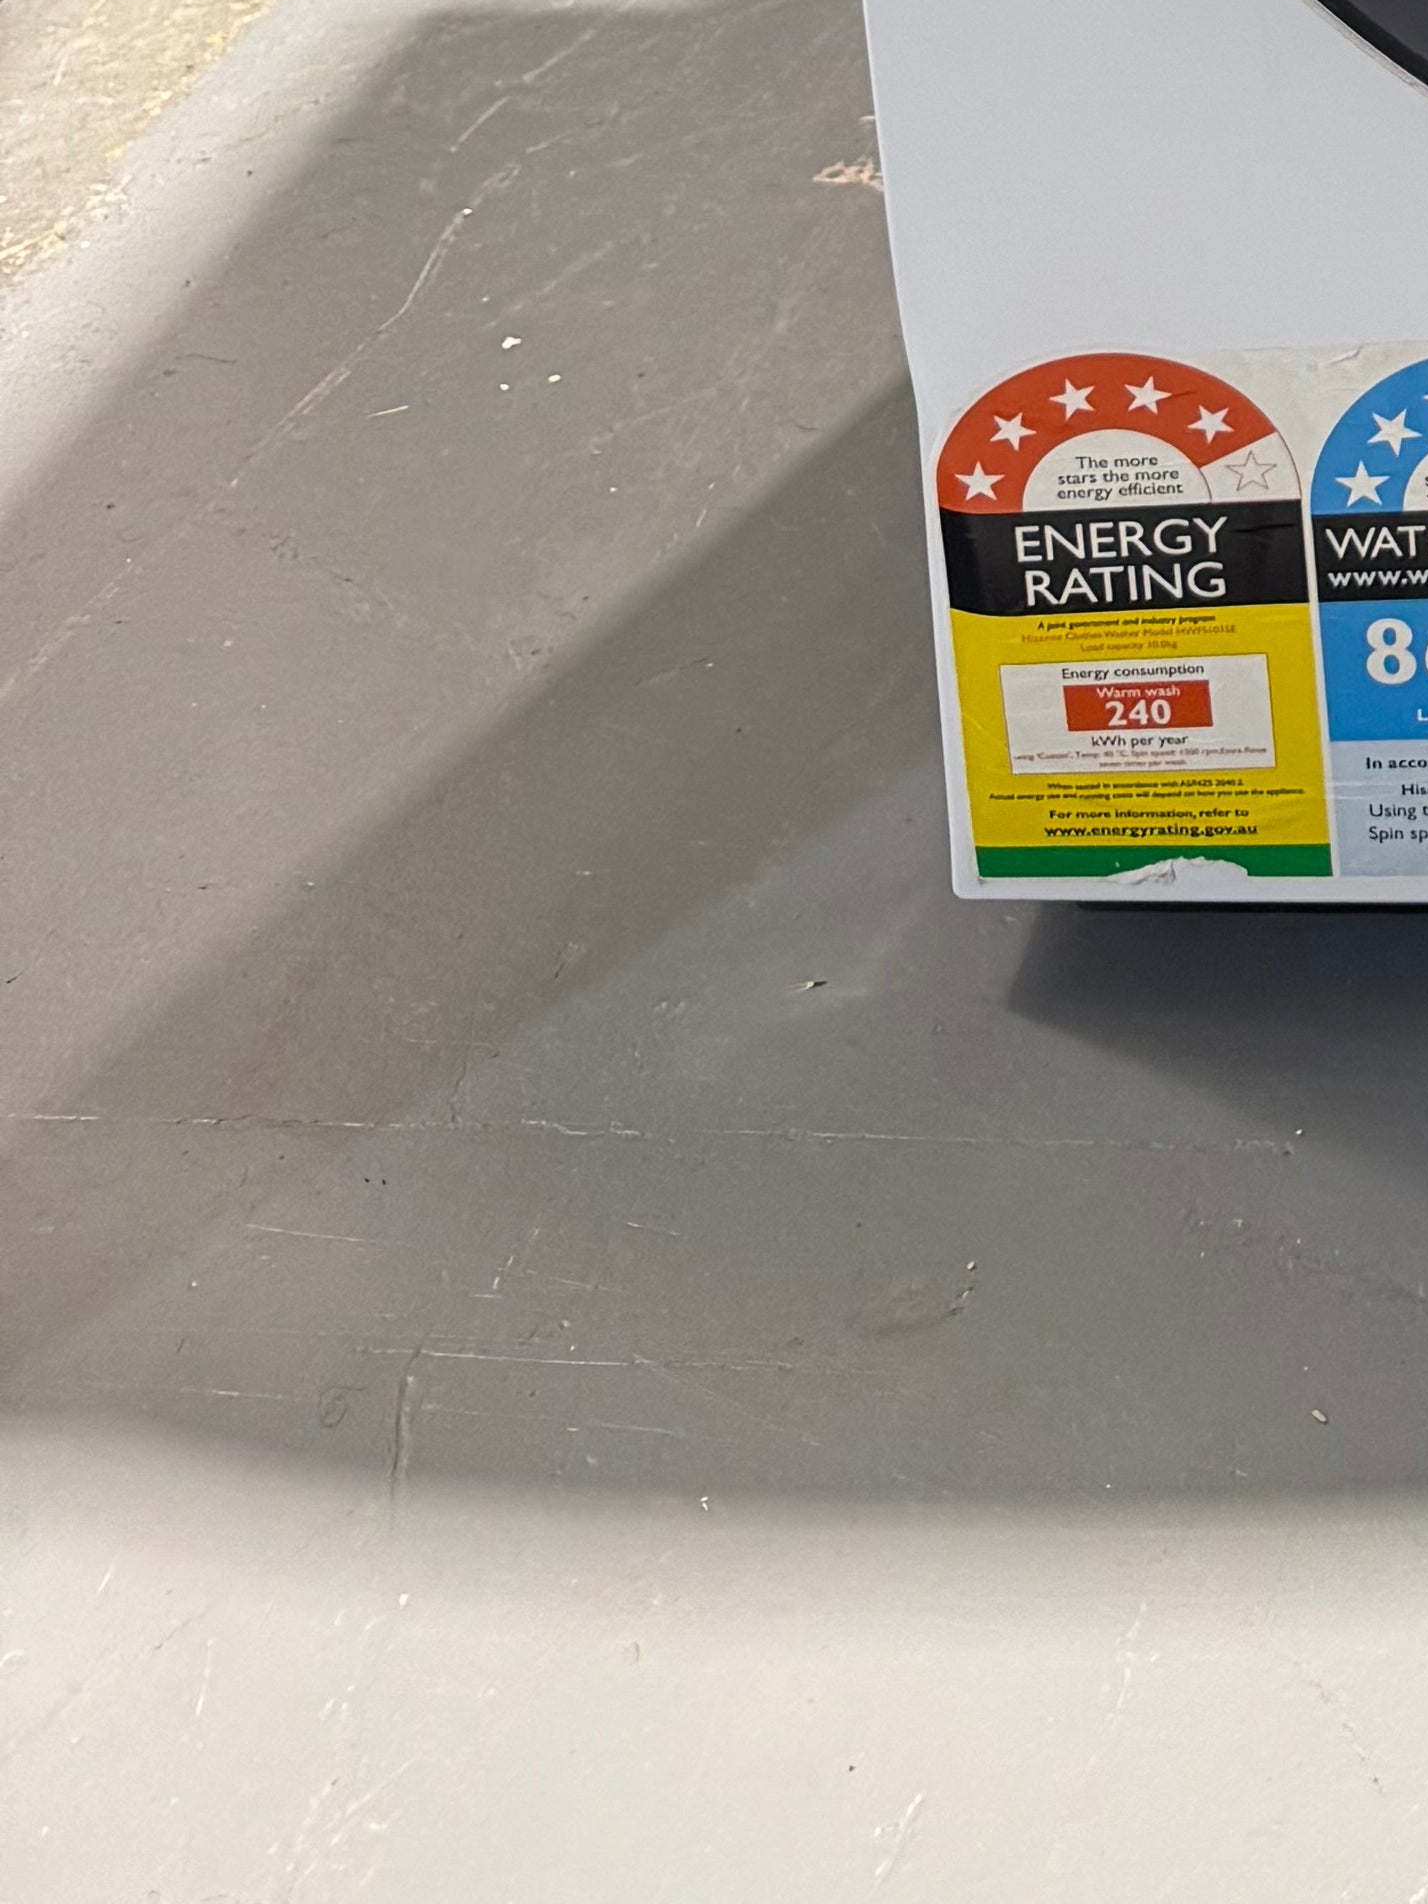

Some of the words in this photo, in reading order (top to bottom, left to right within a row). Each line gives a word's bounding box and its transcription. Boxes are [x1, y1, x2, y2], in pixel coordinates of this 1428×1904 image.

[1075, 456, 1108, 469] The
[1114, 456, 1158, 467] more
[1058, 473, 1097, 485] stars
[1103, 470, 1129, 483] the
[1135, 470, 1180, 481] more
[1057, 487, 1113, 501] energy
[1118, 483, 1184, 497] efficient
[1014, 515, 1229, 564] ENERGY
[1024, 562, 1227, 607] RATING
[1061, 667, 1109, 680] Energy
[1114, 664, 1205, 678] consumption
[1096, 686, 1142, 698] Warm
[1145, 685, 1181, 697] wash
[1105, 699, 1172, 727] 240
[1091, 736, 1126, 747] kWh
[1130, 737, 1156, 749] per
[1159, 735, 1189, 748] year
[1366, 756, 1383, 769] In
[1049, 809, 1071, 819] For
[1076, 810, 1111, 819] more
[1115, 808, 1197, 820] information,
[1199, 808, 1230, 818] refer
[1234, 808, 1249, 817] to
[1369, 803, 1417, 821] Using
[1044, 823, 1258, 838] www.energyrating.gov.au
[1368, 825, 1404, 844] Spin
